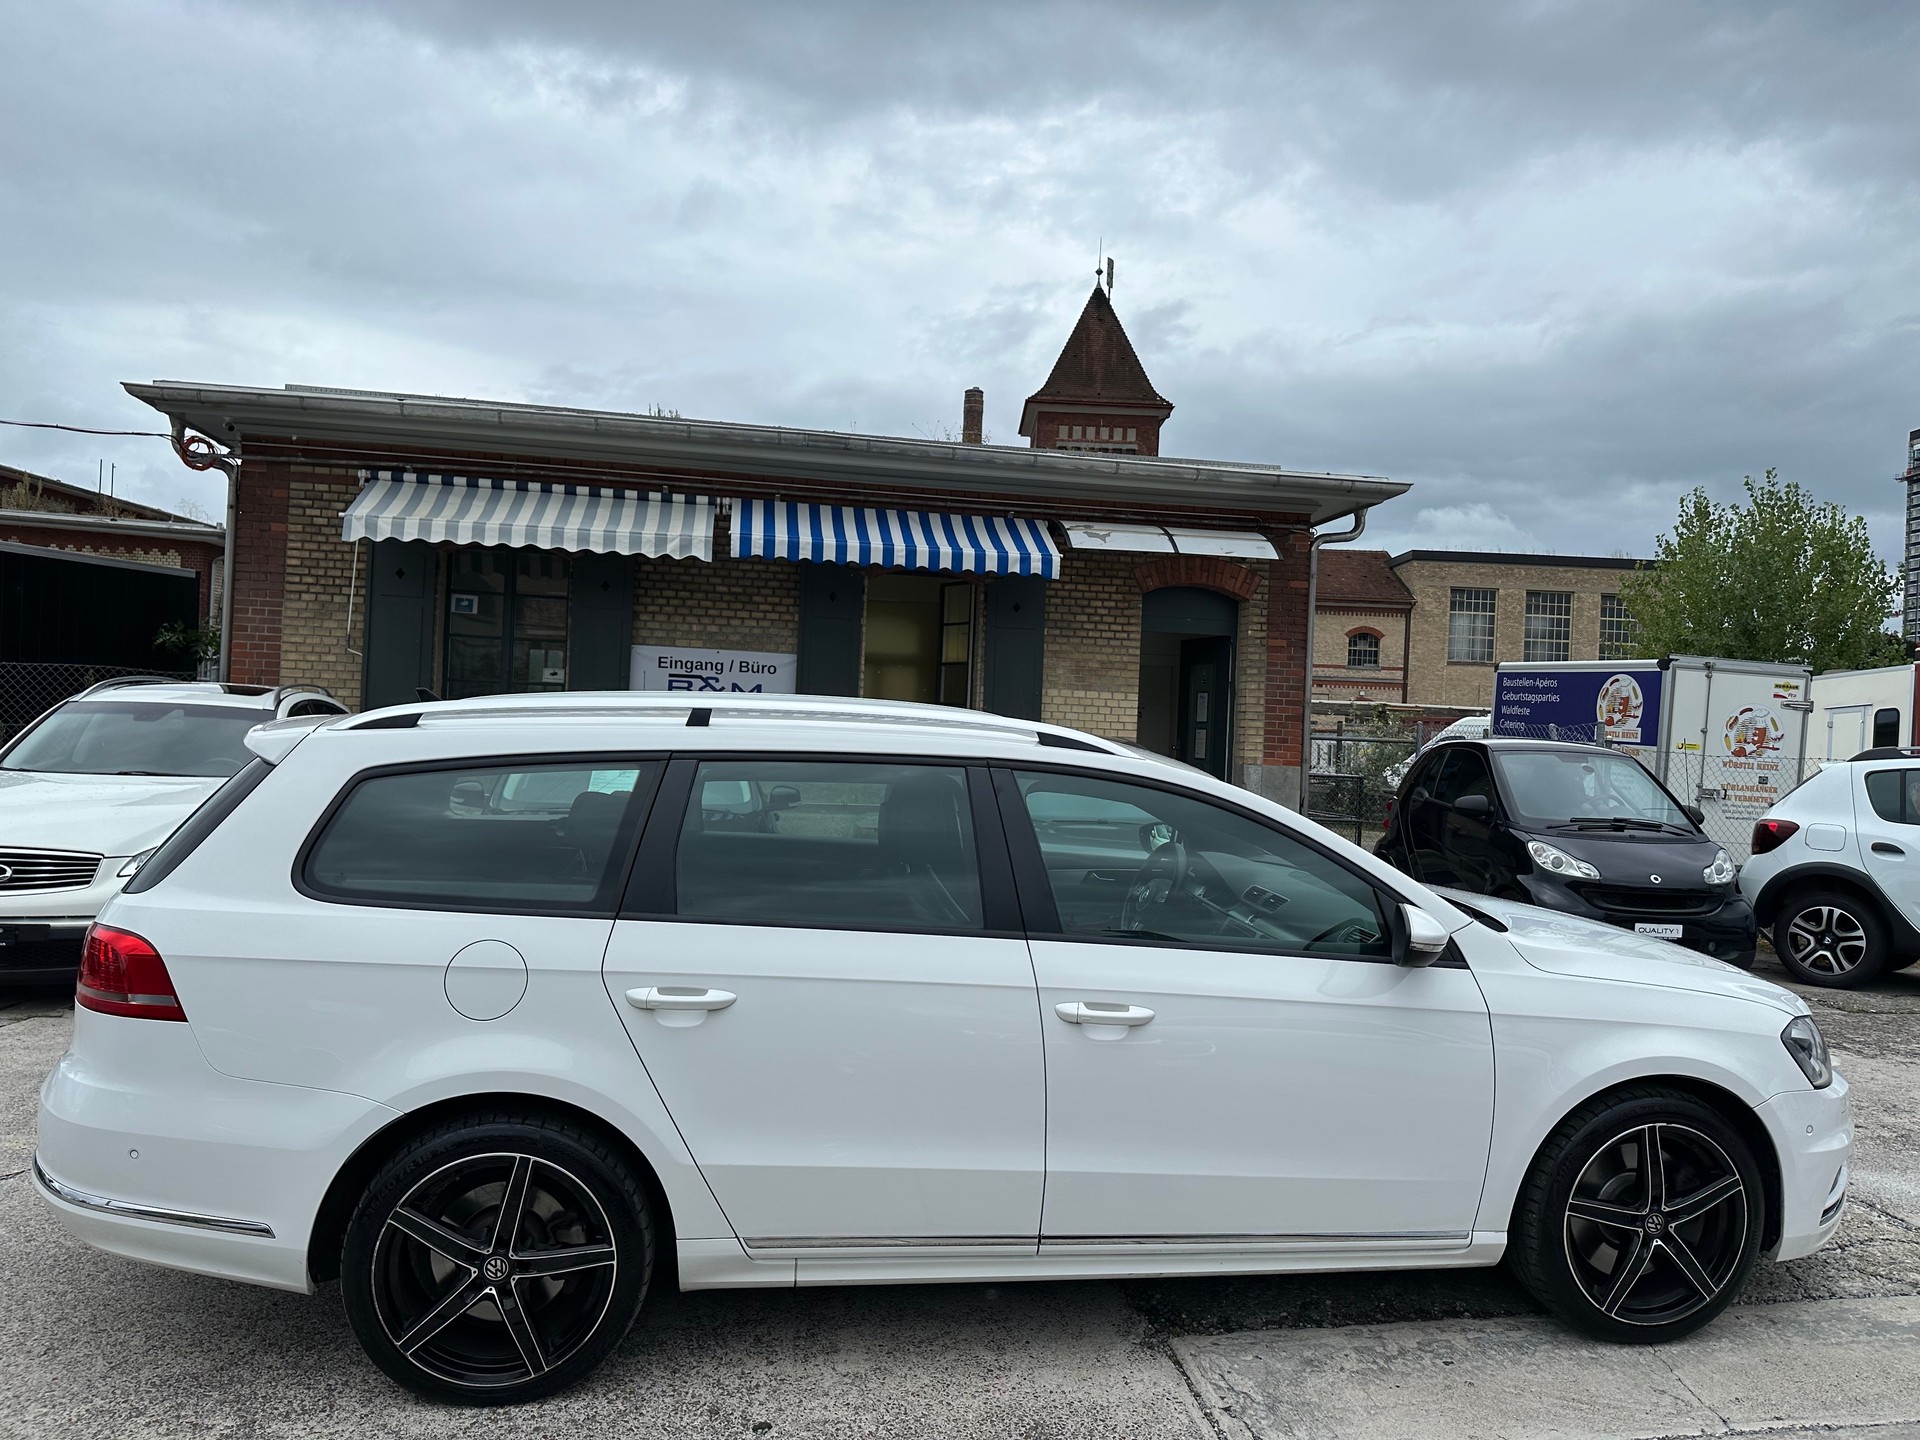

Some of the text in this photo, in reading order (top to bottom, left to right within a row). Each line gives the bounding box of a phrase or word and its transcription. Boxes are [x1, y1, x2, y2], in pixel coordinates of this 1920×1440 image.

[657, 656, 777, 675] Eingang / Büro
[1502, 678, 1558, 689] Baustellen-Apéros
[1501, 692, 1560, 704] Geburtstagsparties
[1501, 704, 1531, 716] Waldfeste
[1500, 718, 1525, 731] Catering
[1638, 926, 1674, 934] QUALITY
